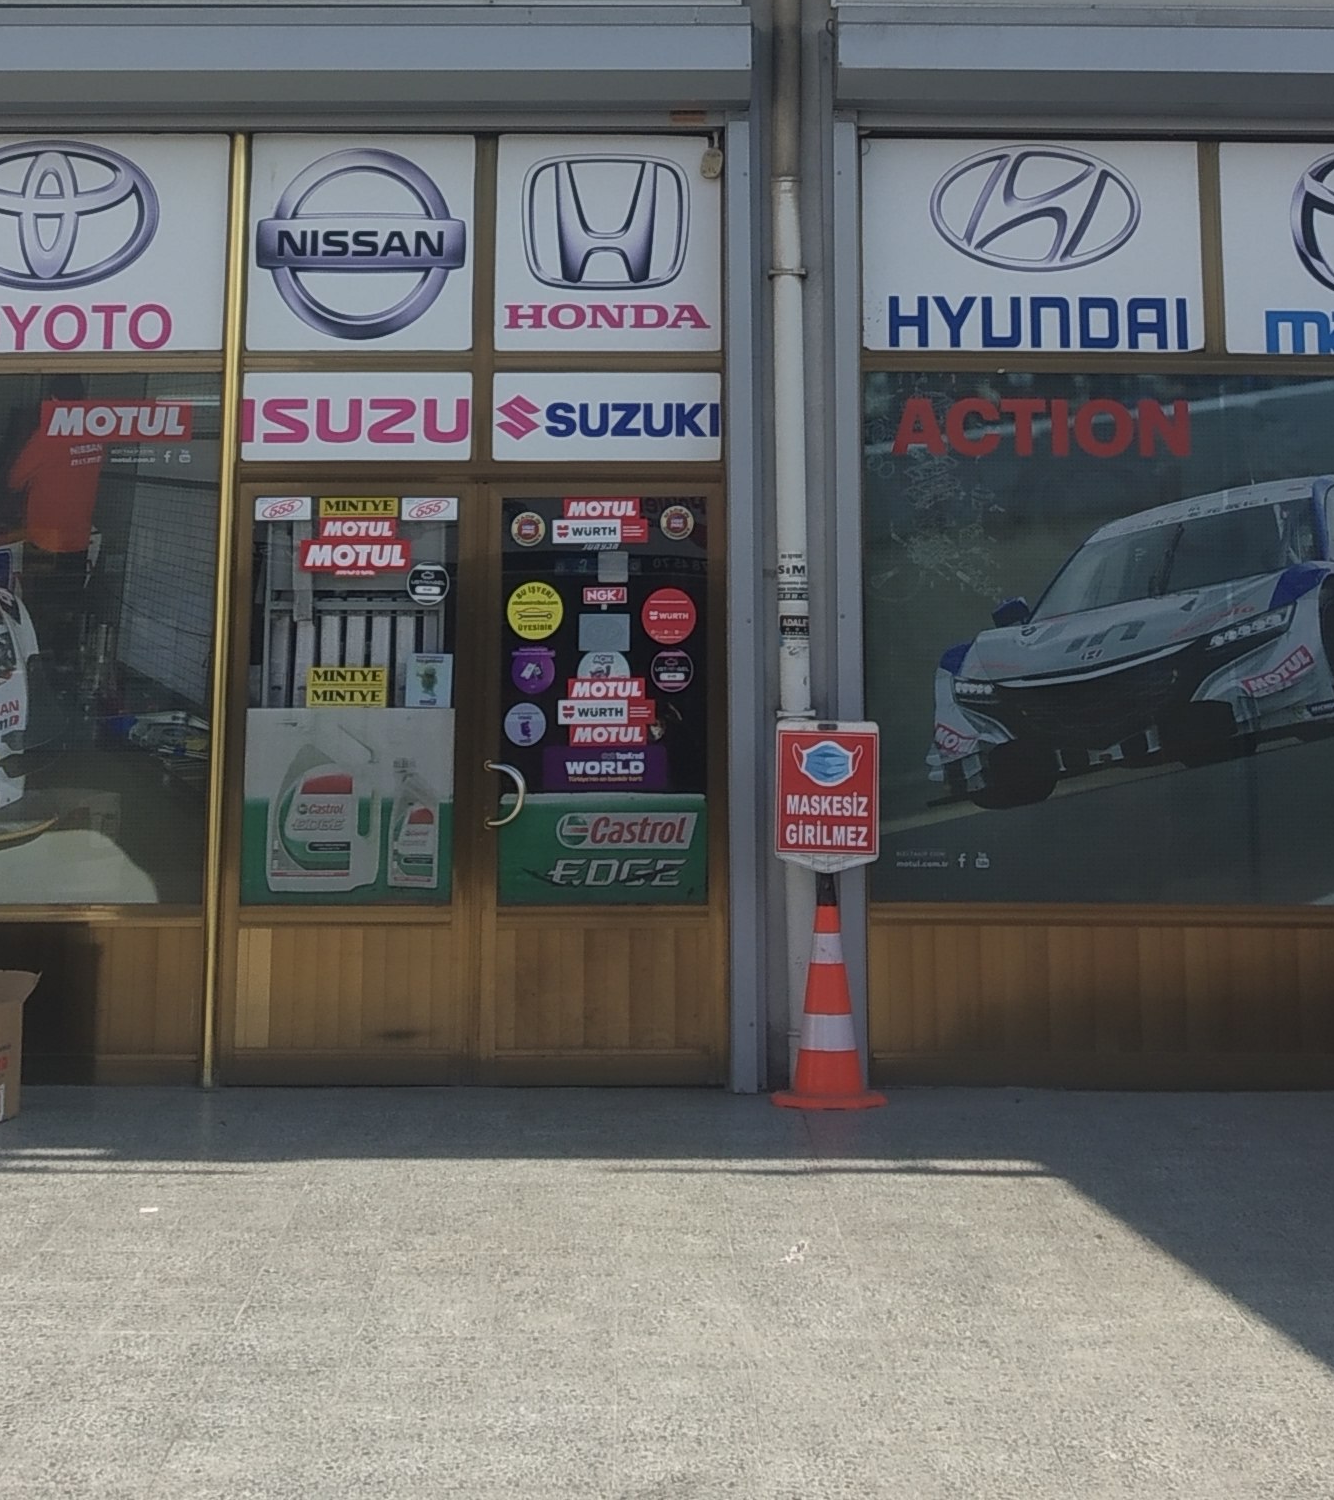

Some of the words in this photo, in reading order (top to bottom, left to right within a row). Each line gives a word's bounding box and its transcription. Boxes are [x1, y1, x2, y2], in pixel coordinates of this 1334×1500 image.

[277, 230, 445, 257] NISSAN
[504, 304, 711, 329] HONDA
[888, 296, 1188, 350] HYUNDAI
[47, 406, 186, 437] MOTUL
[241, 398, 469, 444] ISUZU
[545, 402, 720, 438] SUZUKI
[891, 397, 1192, 458] ACTION
[269, 501, 295, 516] 555
[324, 500, 394, 512] MINTYE
[415, 502, 442, 516] 555
[568, 501, 636, 516] MOTUL
[323, 521, 392, 536] MOTUL
[572, 526, 617, 536] WÜRTH
[304, 544, 405, 567] MOTUL
[586, 589, 617, 601] NGK
[312, 670, 382, 682] MINTYE
[1248, 649, 1313, 692] MOTUL
[311, 690, 382, 702] MINTYE
[571, 681, 642, 698] MOTUL
[578, 707, 624, 717] WÜRTH
[573, 727, 643, 743] MOTUL
[565, 761, 645, 775] WORLD
[309, 803, 343, 814] Castrol
[786, 792, 868, 817] MASKESİZ
[590, 816, 687, 844] Castrol
[785, 822, 868, 847] GİRİLMEZ
[548, 859, 687, 886] EDGE
